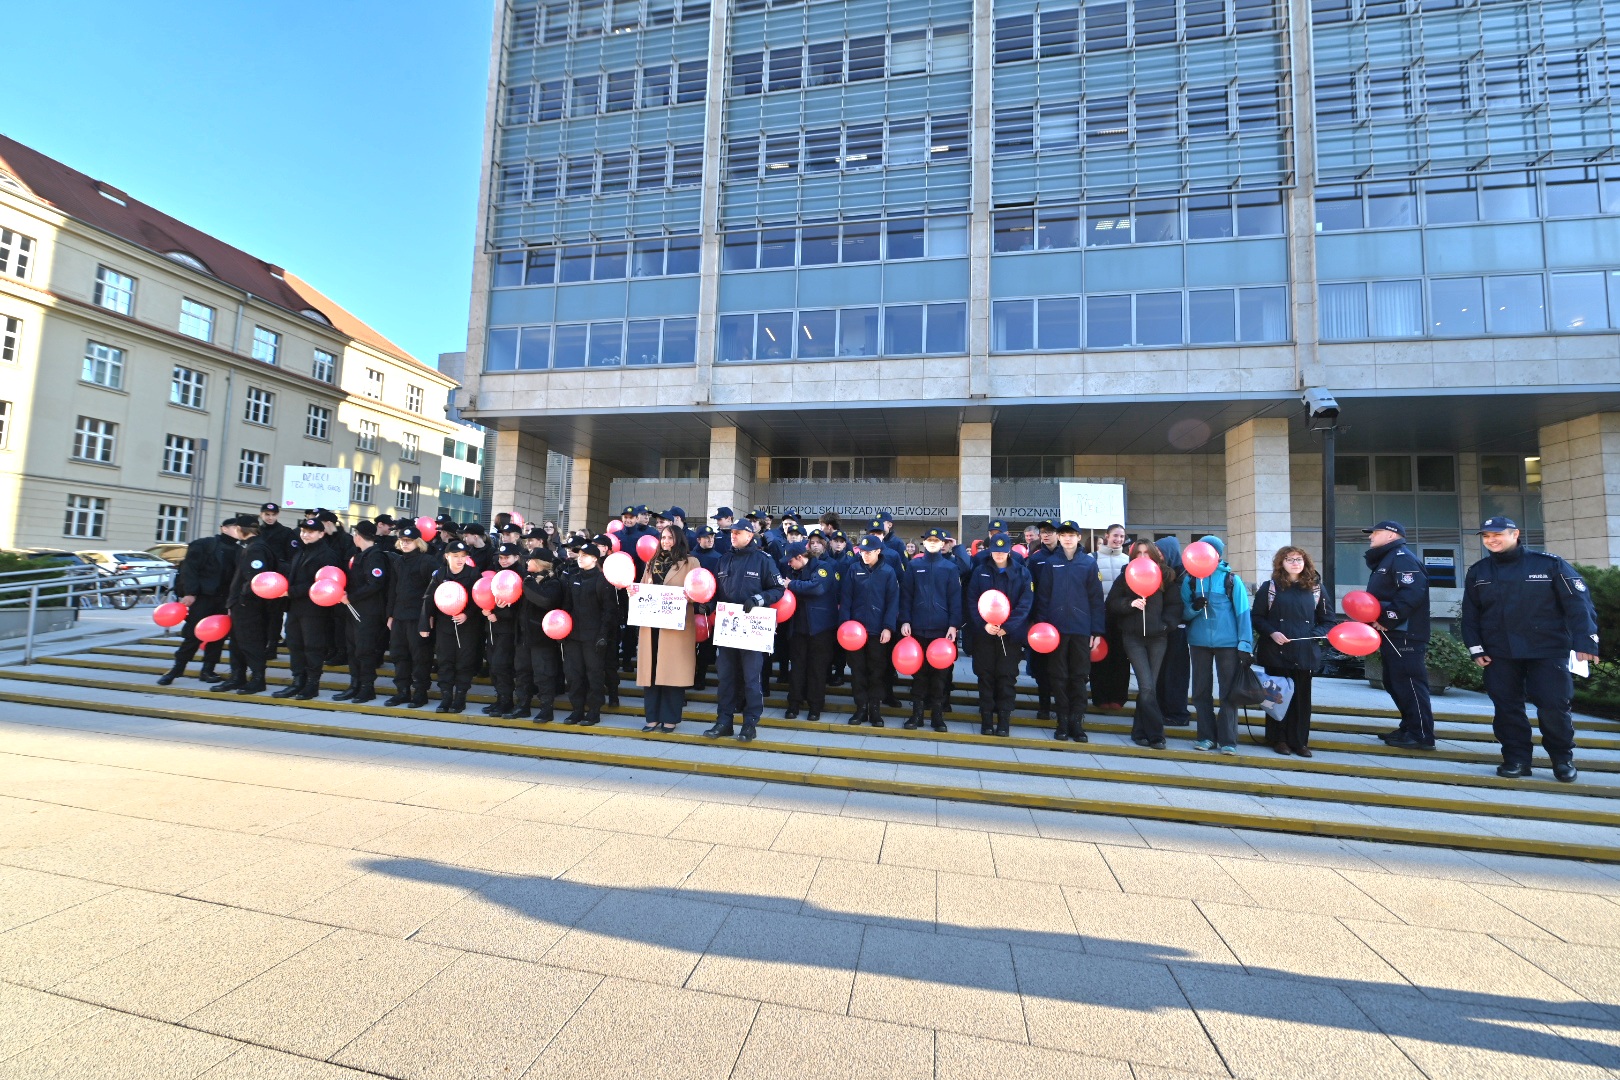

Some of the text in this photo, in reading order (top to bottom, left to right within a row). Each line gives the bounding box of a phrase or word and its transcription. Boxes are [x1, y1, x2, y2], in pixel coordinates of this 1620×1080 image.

[303, 473, 329, 482] DZIECI
[759, 505, 1061, 518] WIELKOPOLSKI URZĄD WOJEWÓDZKI W POZNANI
